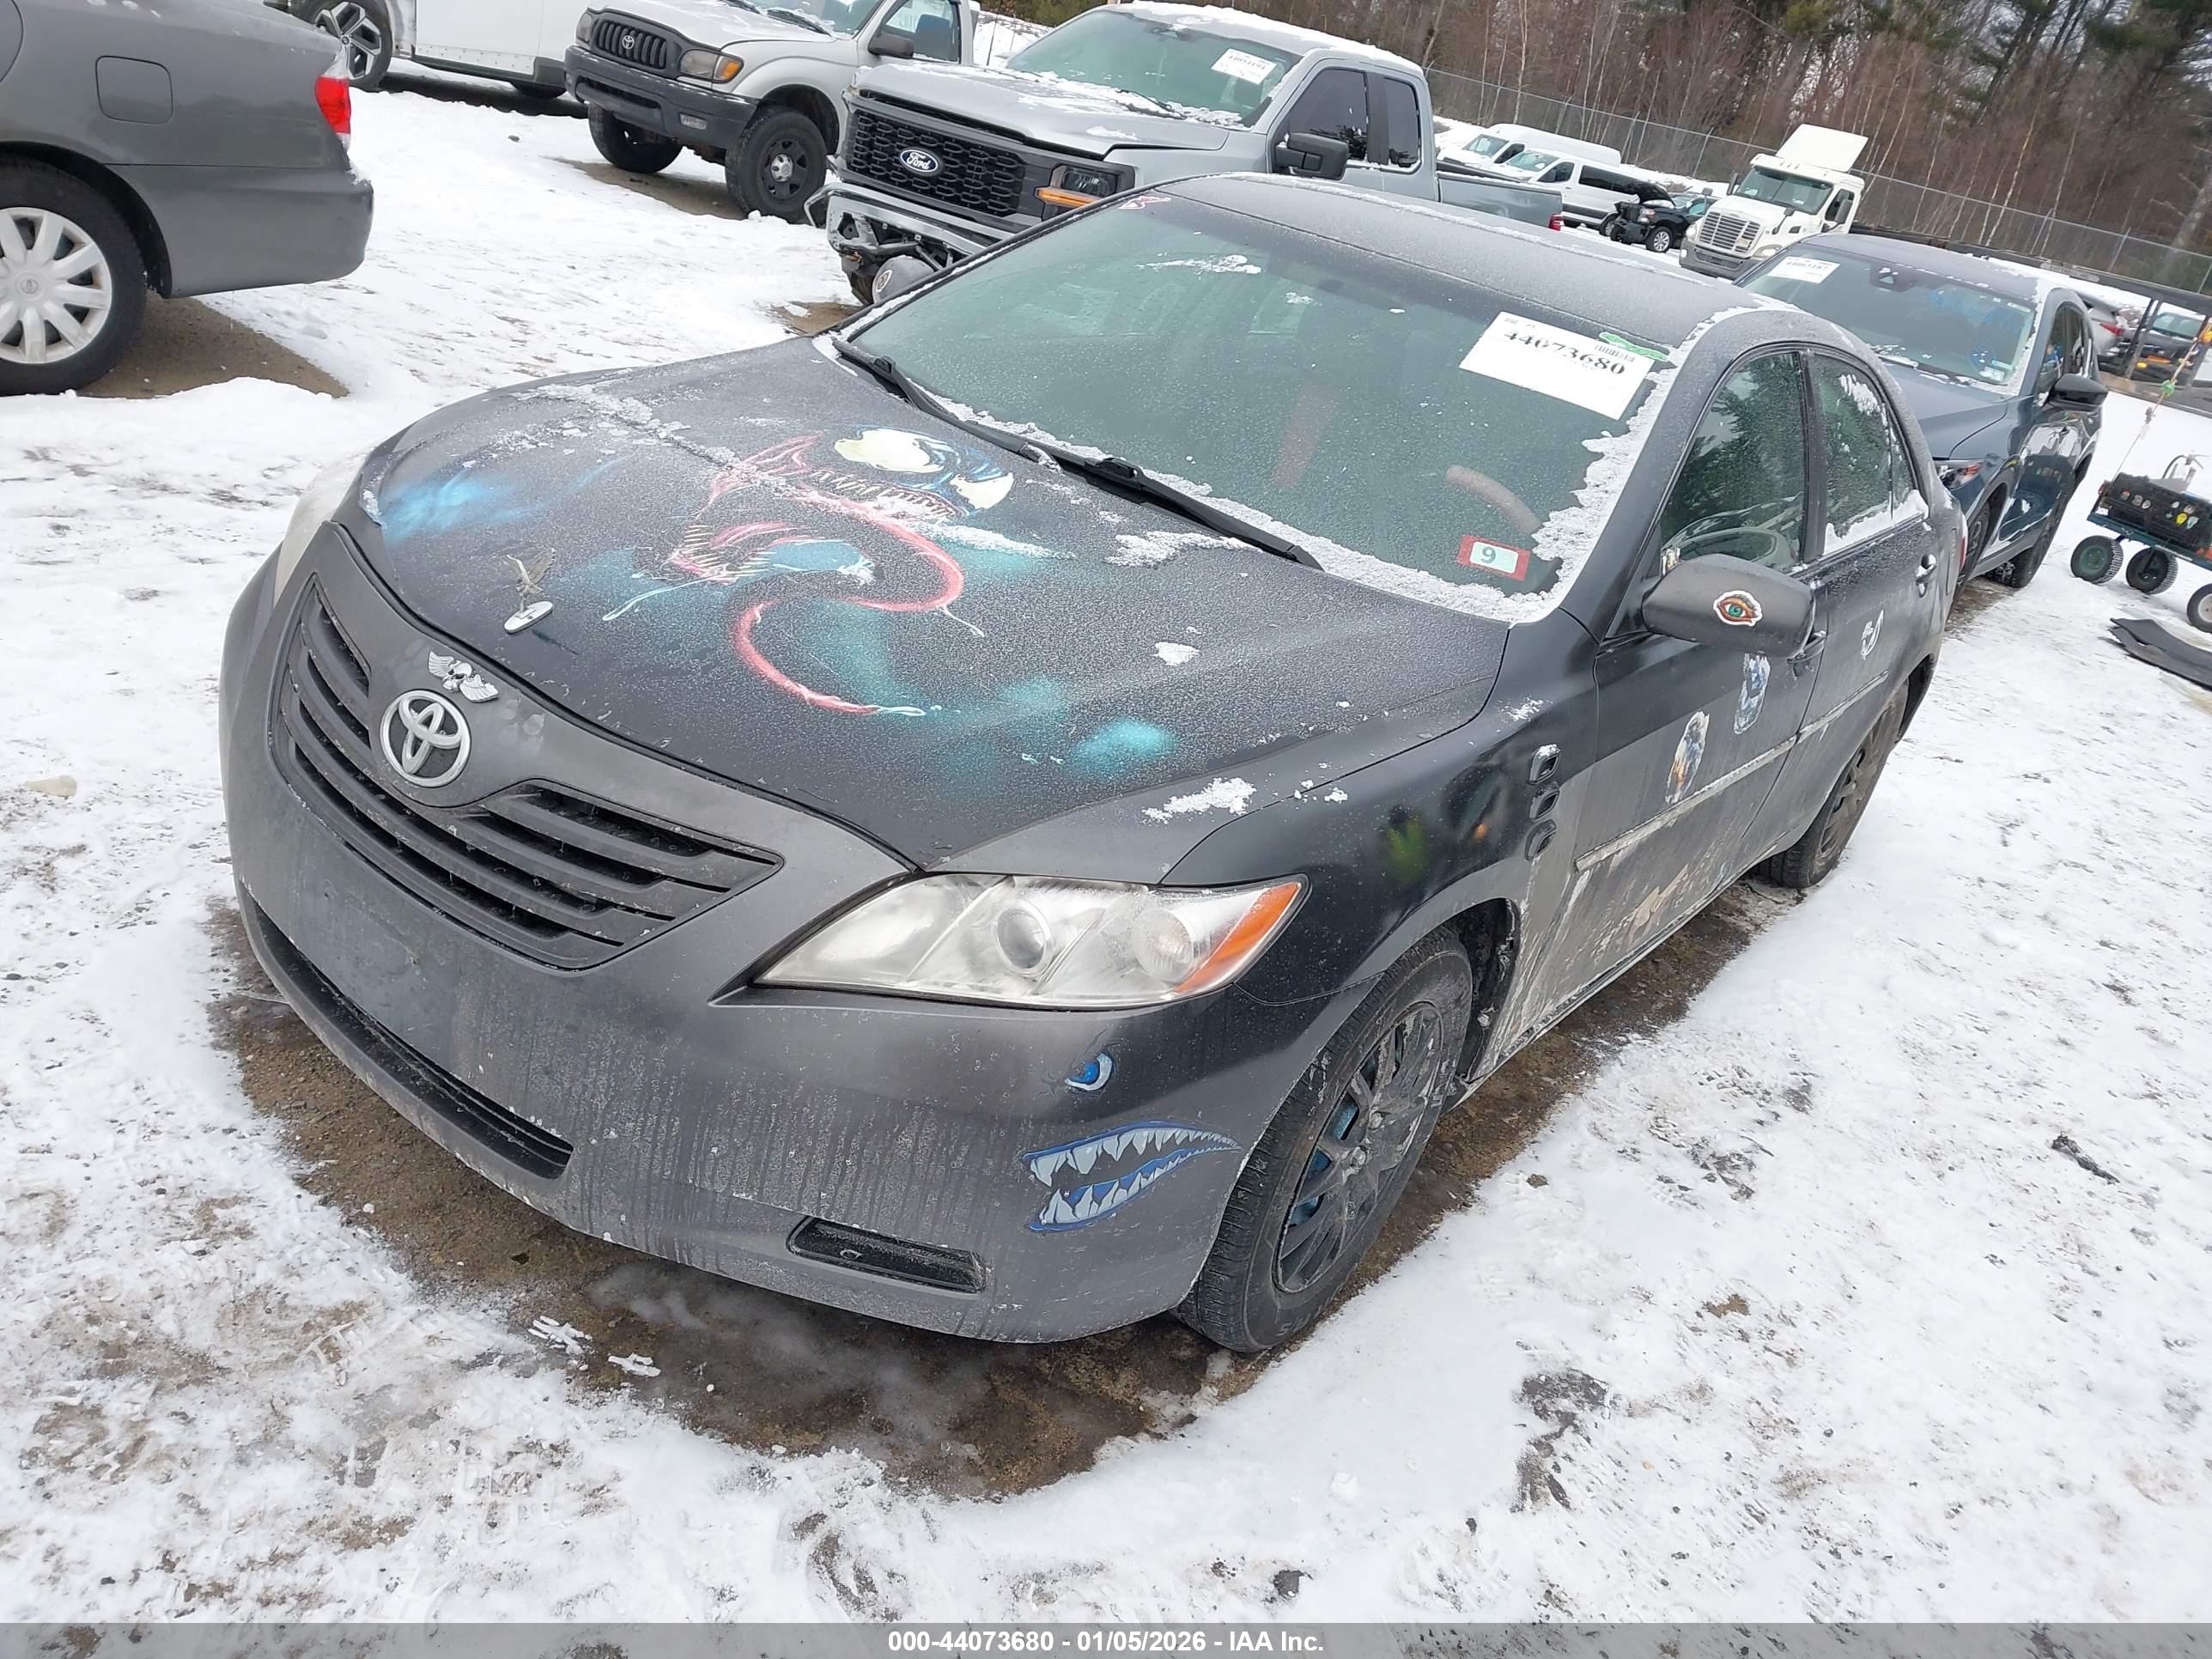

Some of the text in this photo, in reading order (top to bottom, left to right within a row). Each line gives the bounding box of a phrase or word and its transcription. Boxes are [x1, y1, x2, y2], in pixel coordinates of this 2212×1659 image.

[906, 152, 932, 170] Ford
[1504, 331, 1626, 375] 44073680
[1480, 546, 1497, 564] 9
